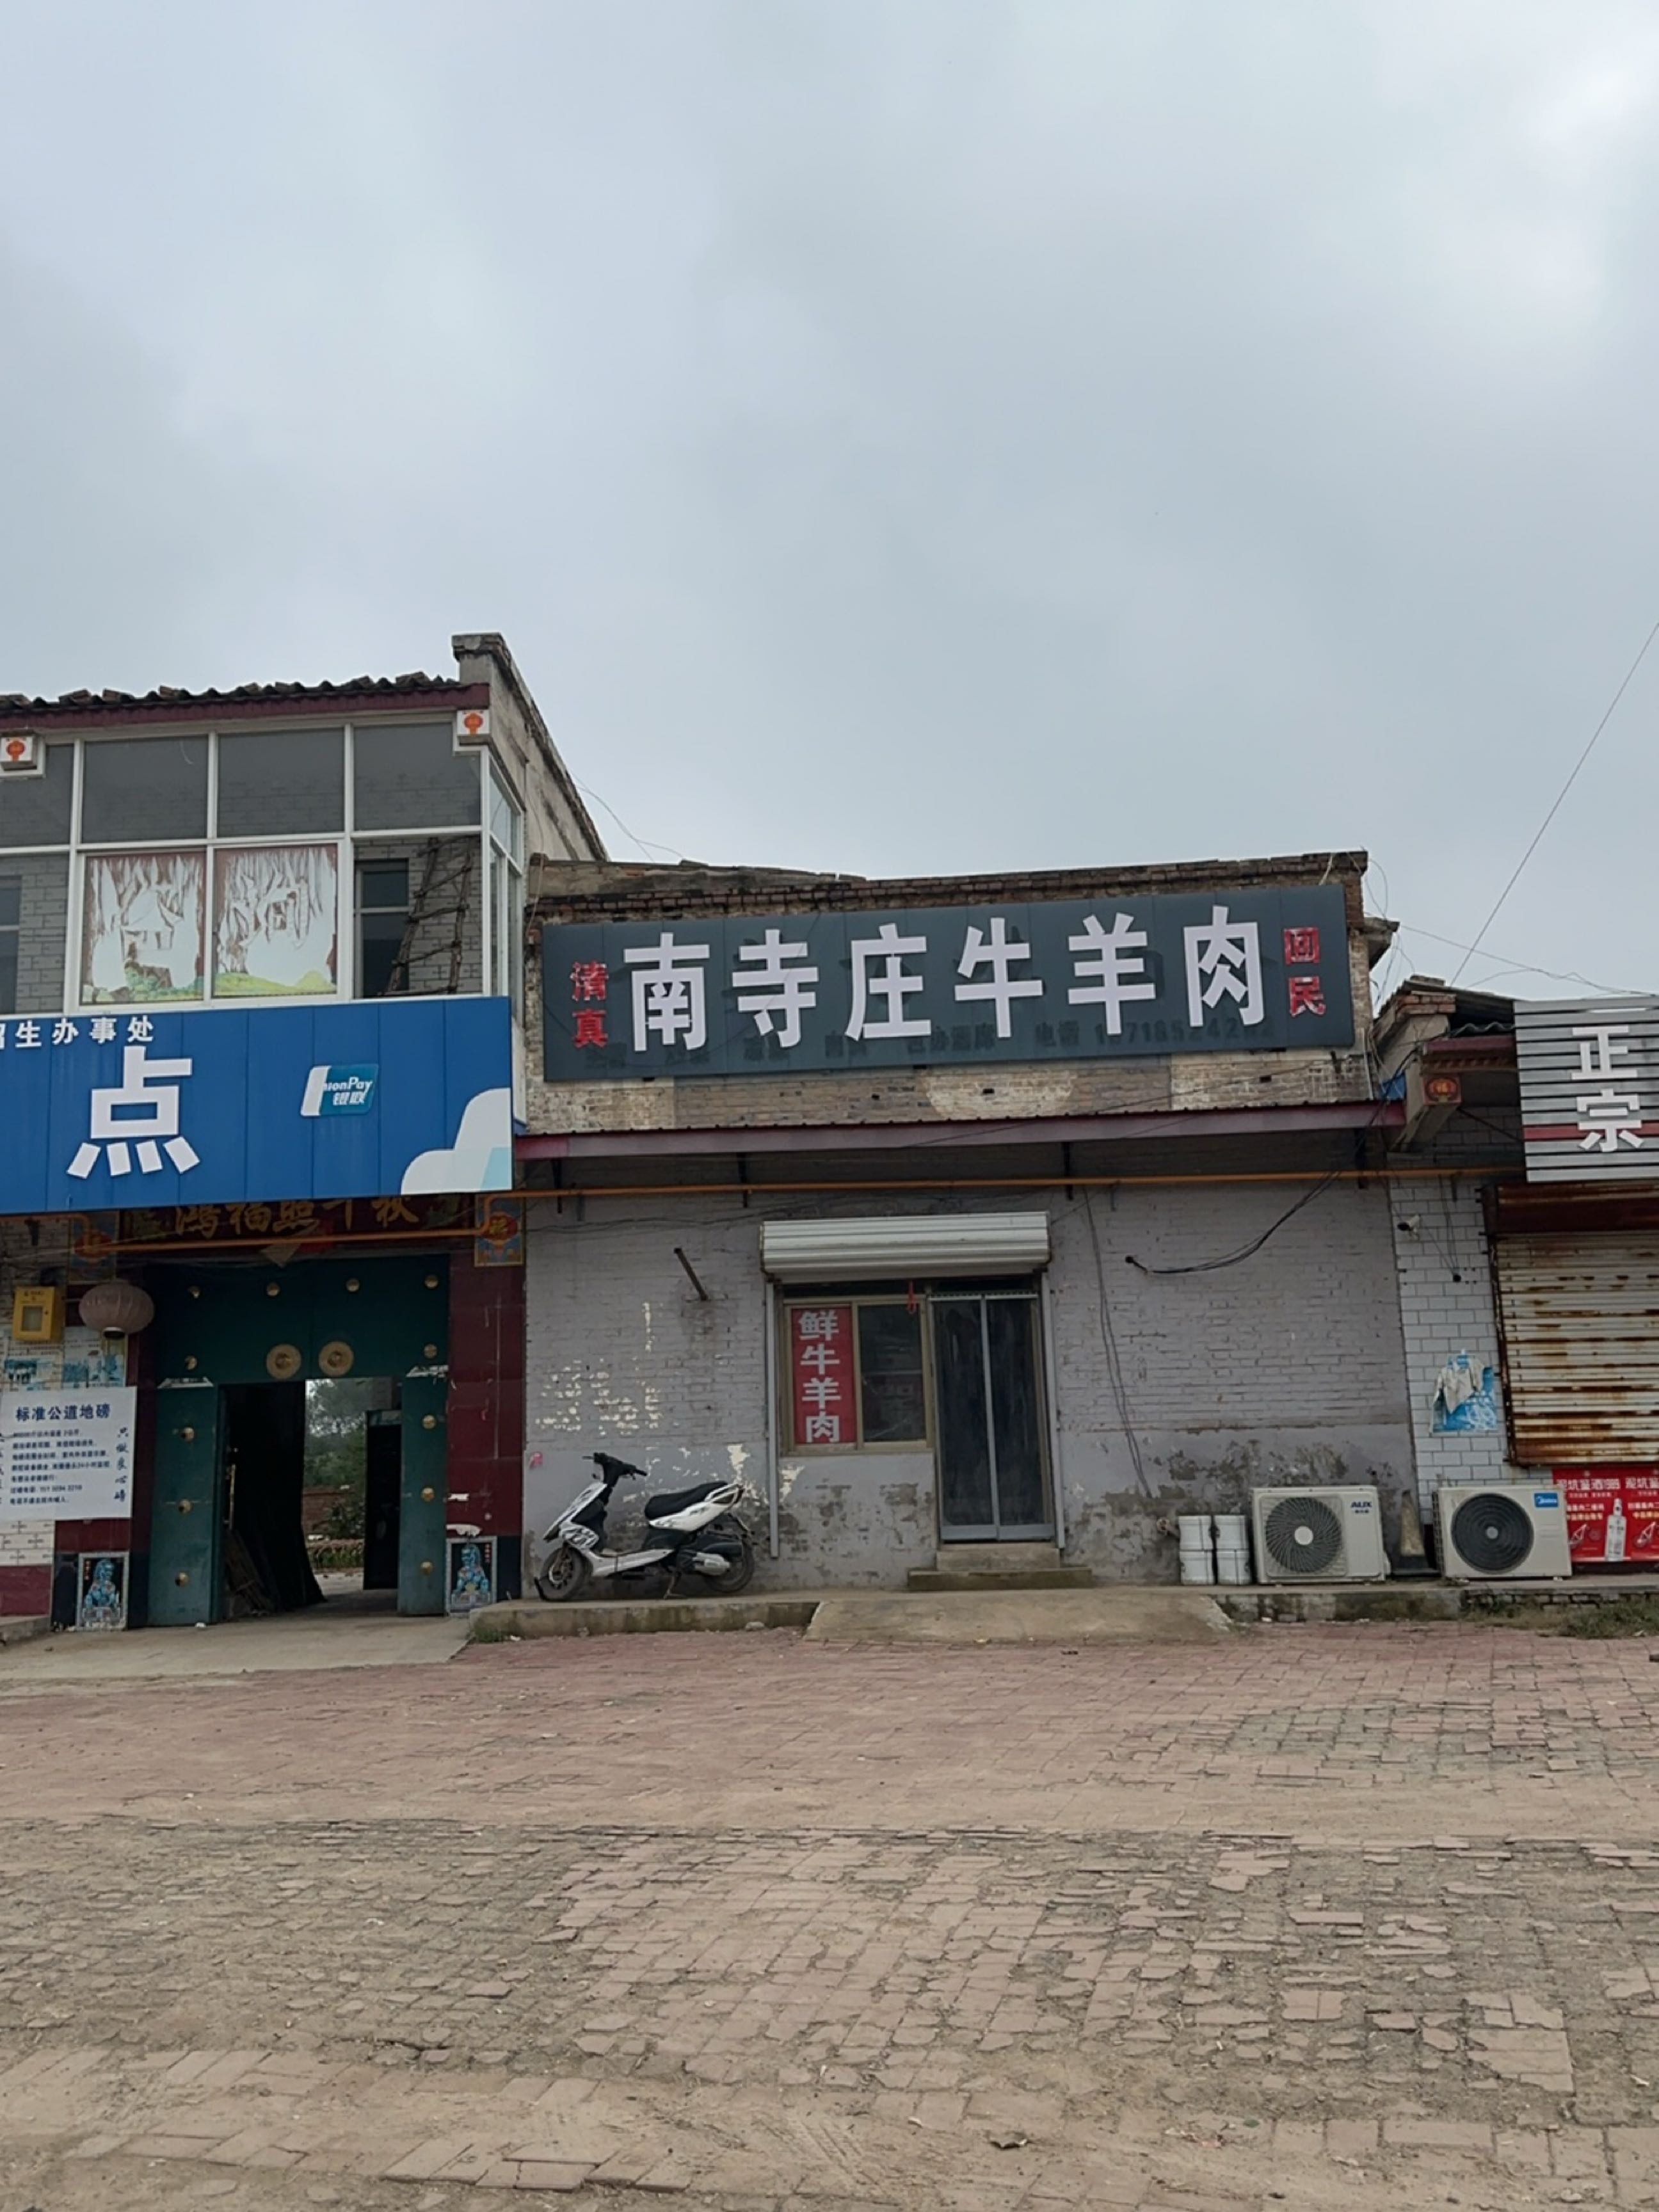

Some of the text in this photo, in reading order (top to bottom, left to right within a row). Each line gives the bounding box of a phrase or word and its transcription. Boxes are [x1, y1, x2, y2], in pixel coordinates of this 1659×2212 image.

[570, 959, 609, 1048] 清真
[623, 905, 1264, 1052] 南寺庄牛羊肉
[1284, 927, 1327, 1018] 回民
[0, 1014, 154, 1050] 生办事处
[67, 1045, 200, 1179] 点
[321, 1075, 374, 1094] nionPay
[1571, 1025, 1644, 1152] 正宗
[16, 1404, 111, 1422] 标准公道地磅
[799, 1310, 841, 1443] 鲜牛羊肉
